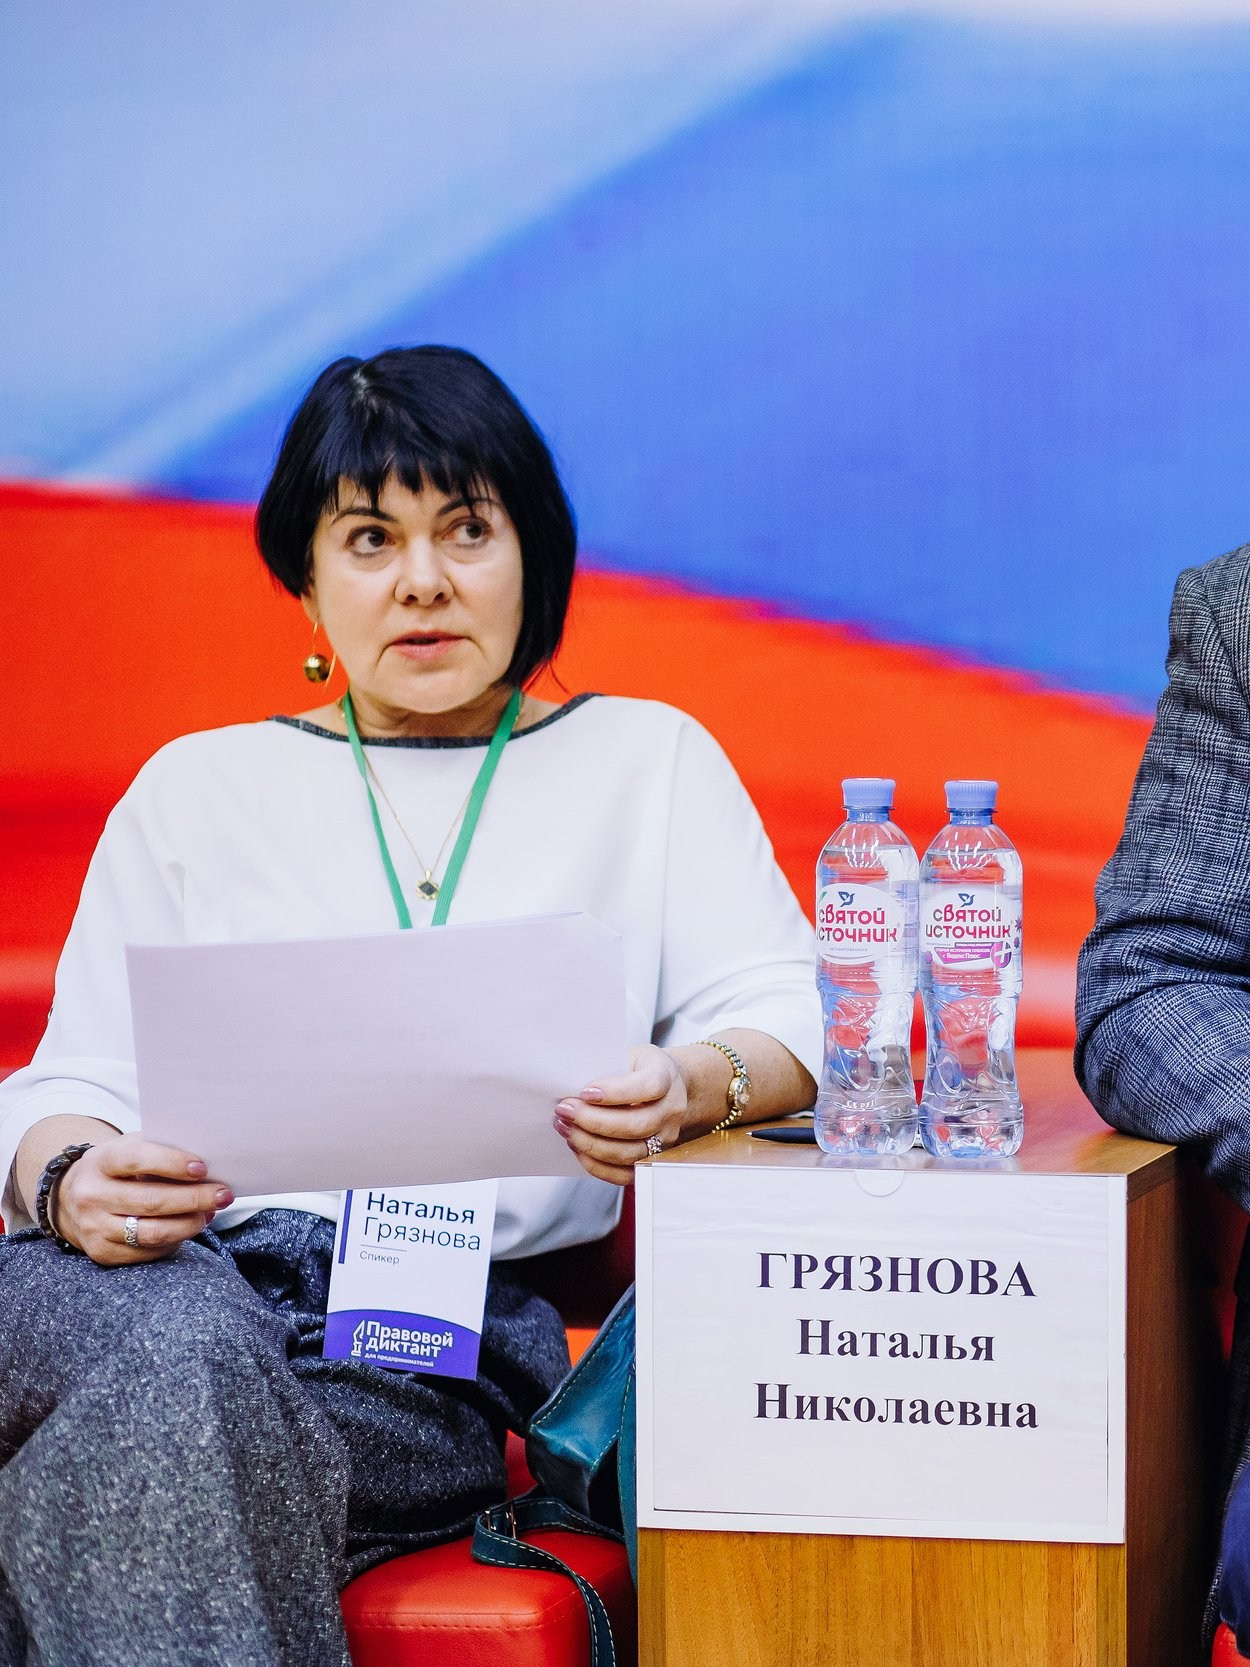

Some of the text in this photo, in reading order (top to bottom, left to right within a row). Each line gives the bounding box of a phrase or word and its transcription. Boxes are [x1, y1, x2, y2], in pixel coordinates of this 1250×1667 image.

[366, 1191, 475, 1225] Наталья
[364, 1216, 481, 1251] Грязнова
[359, 1250, 400, 1265] Спикер
[755, 1252, 1038, 1298] ГРЯЗНОВА
[366, 1320, 453, 1348] Правовой
[795, 1318, 996, 1362] Наталья
[753, 1382, 1040, 1429] Николаевна
